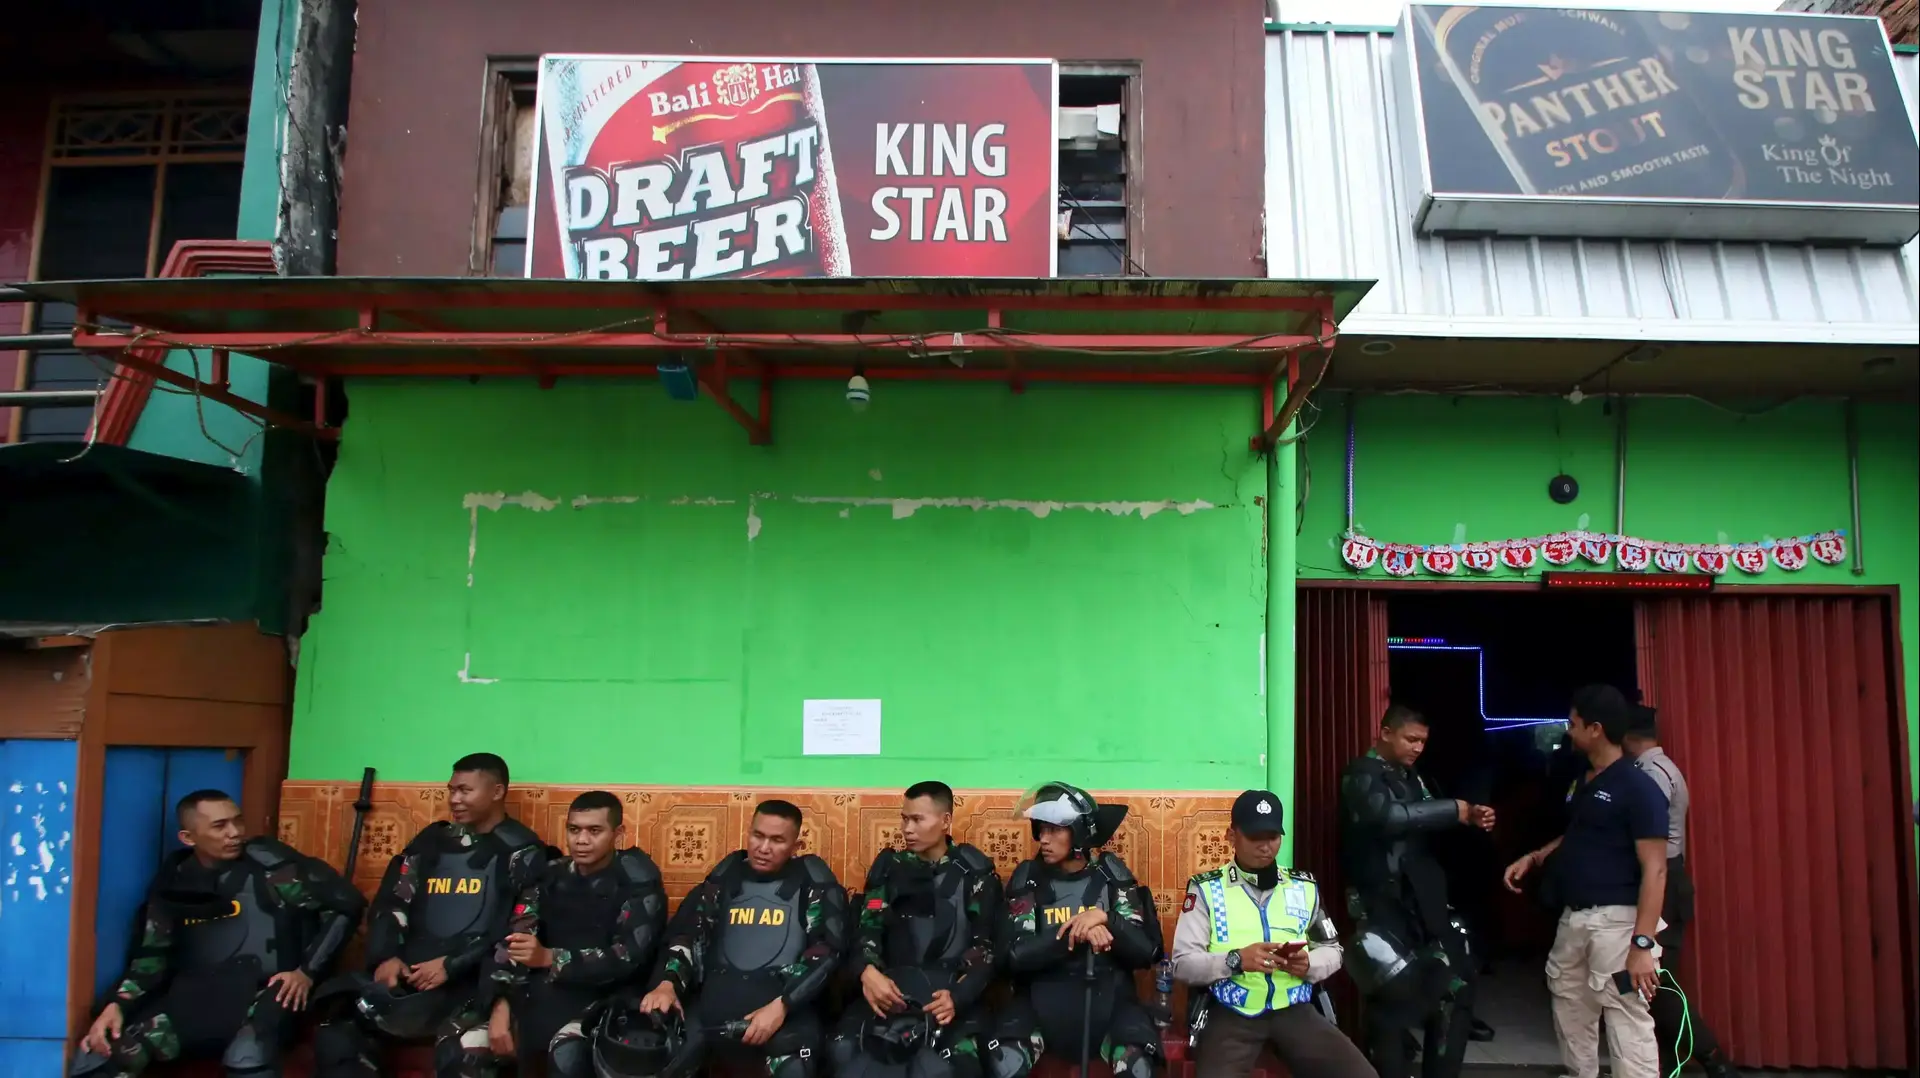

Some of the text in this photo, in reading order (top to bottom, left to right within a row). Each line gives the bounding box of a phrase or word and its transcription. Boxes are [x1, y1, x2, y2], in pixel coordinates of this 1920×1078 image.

[1727, 26, 1857, 69] KING
[648, 81, 712, 117] Bali
[1480, 57, 1680, 141] PANTHER
[1732, 69, 1877, 112] STAR
[874, 122, 1007, 178] KING
[1579, 174, 1609, 193] AND
[1611, 156, 1673, 182] SMOOTH
[1673, 143, 1711, 163] TASTE
[1761, 143, 1853, 167] King Of
[567, 125, 819, 232] DRAFT
[1776, 165, 1895, 190] The Night
[869, 186, 1007, 243] STAR
[582, 198, 806, 280] BEER
[1346, 539, 1839, 574] HAPPY NEW YEAR
[427, 877, 482, 894] TNI AD
[729, 907, 785, 926] TNI AD
[1043, 906, 1071, 925] TNI
